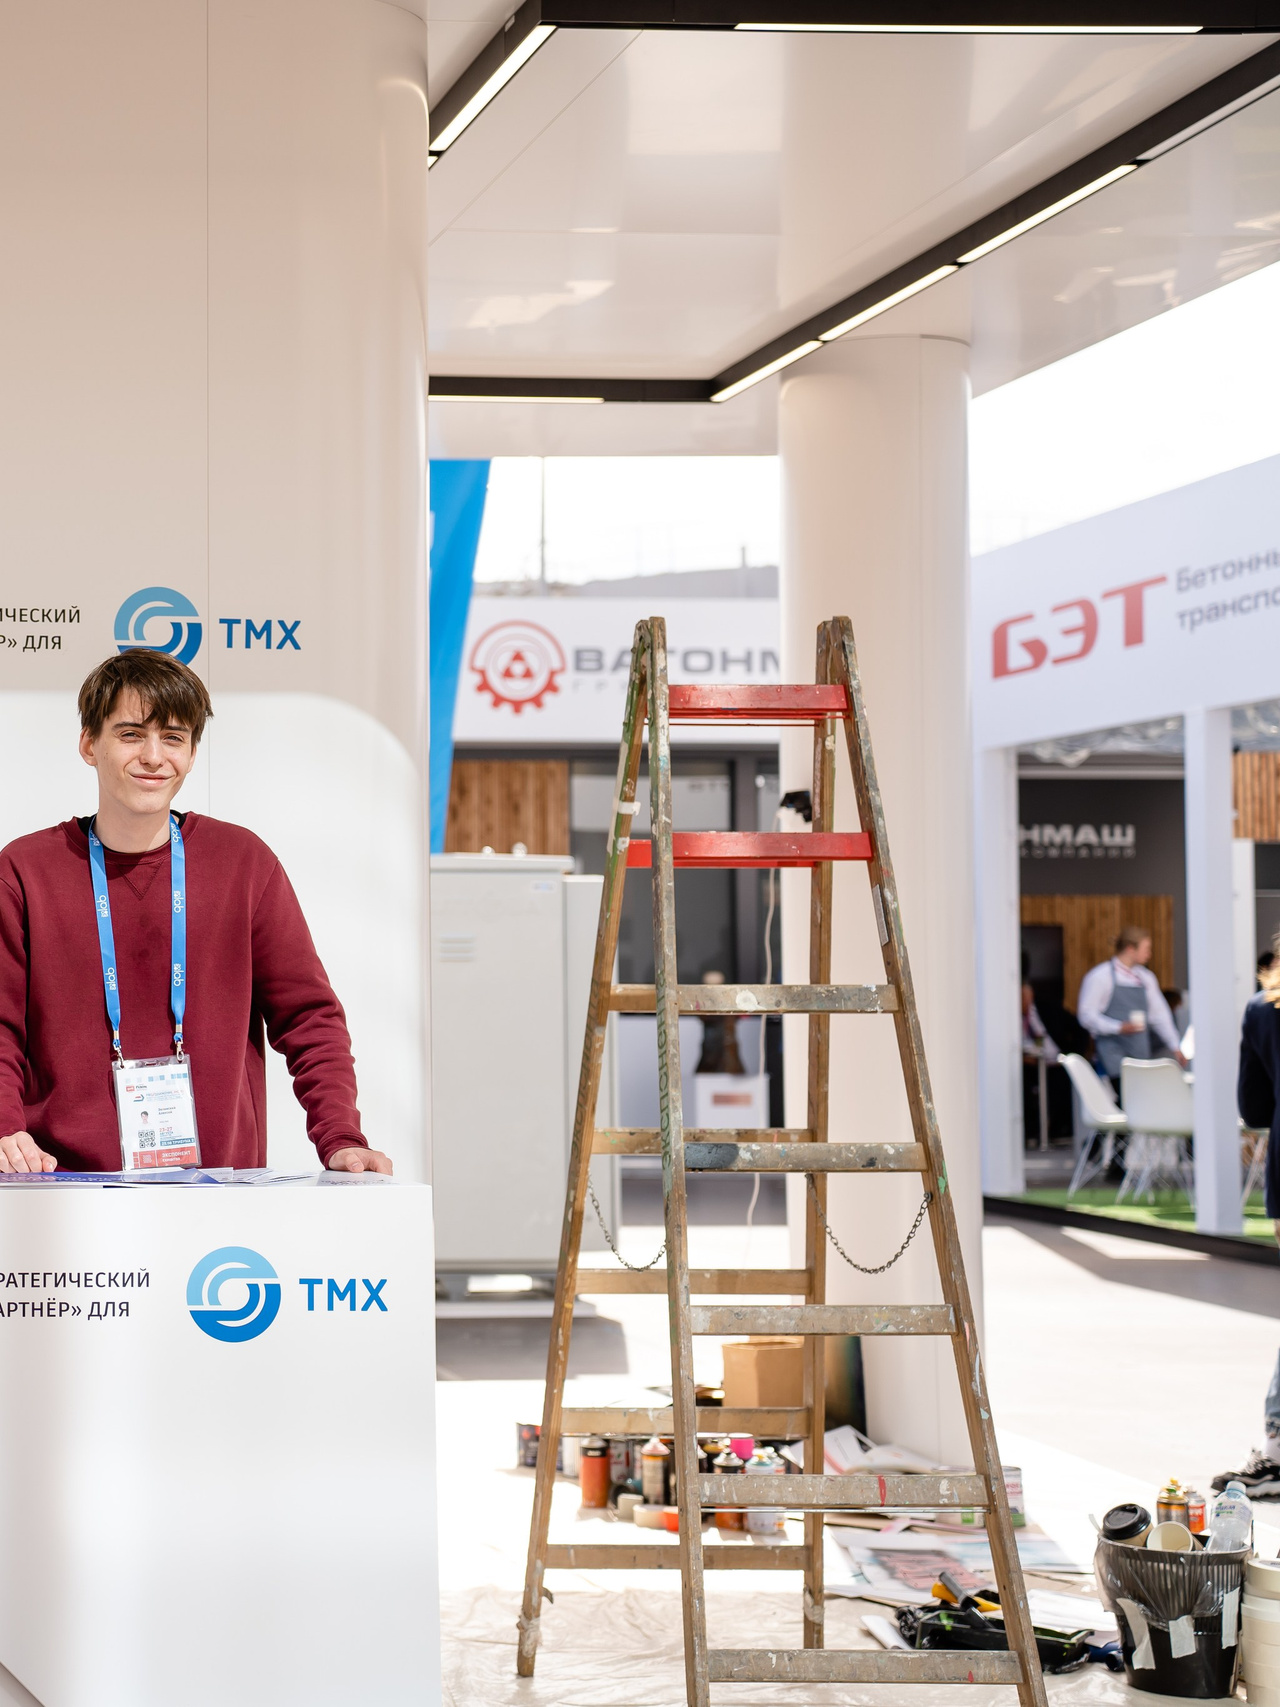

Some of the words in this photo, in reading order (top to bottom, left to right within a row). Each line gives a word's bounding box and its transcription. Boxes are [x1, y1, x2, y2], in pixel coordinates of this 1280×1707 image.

[23, 633, 62, 652] ДЛЯ
[219, 619, 301, 650] ТМХ
[992, 574, 1168, 680] БЭТ
[299, 1278, 388, 1312] ТМХ
[87, 1301, 130, 1321] ДЛЯ
